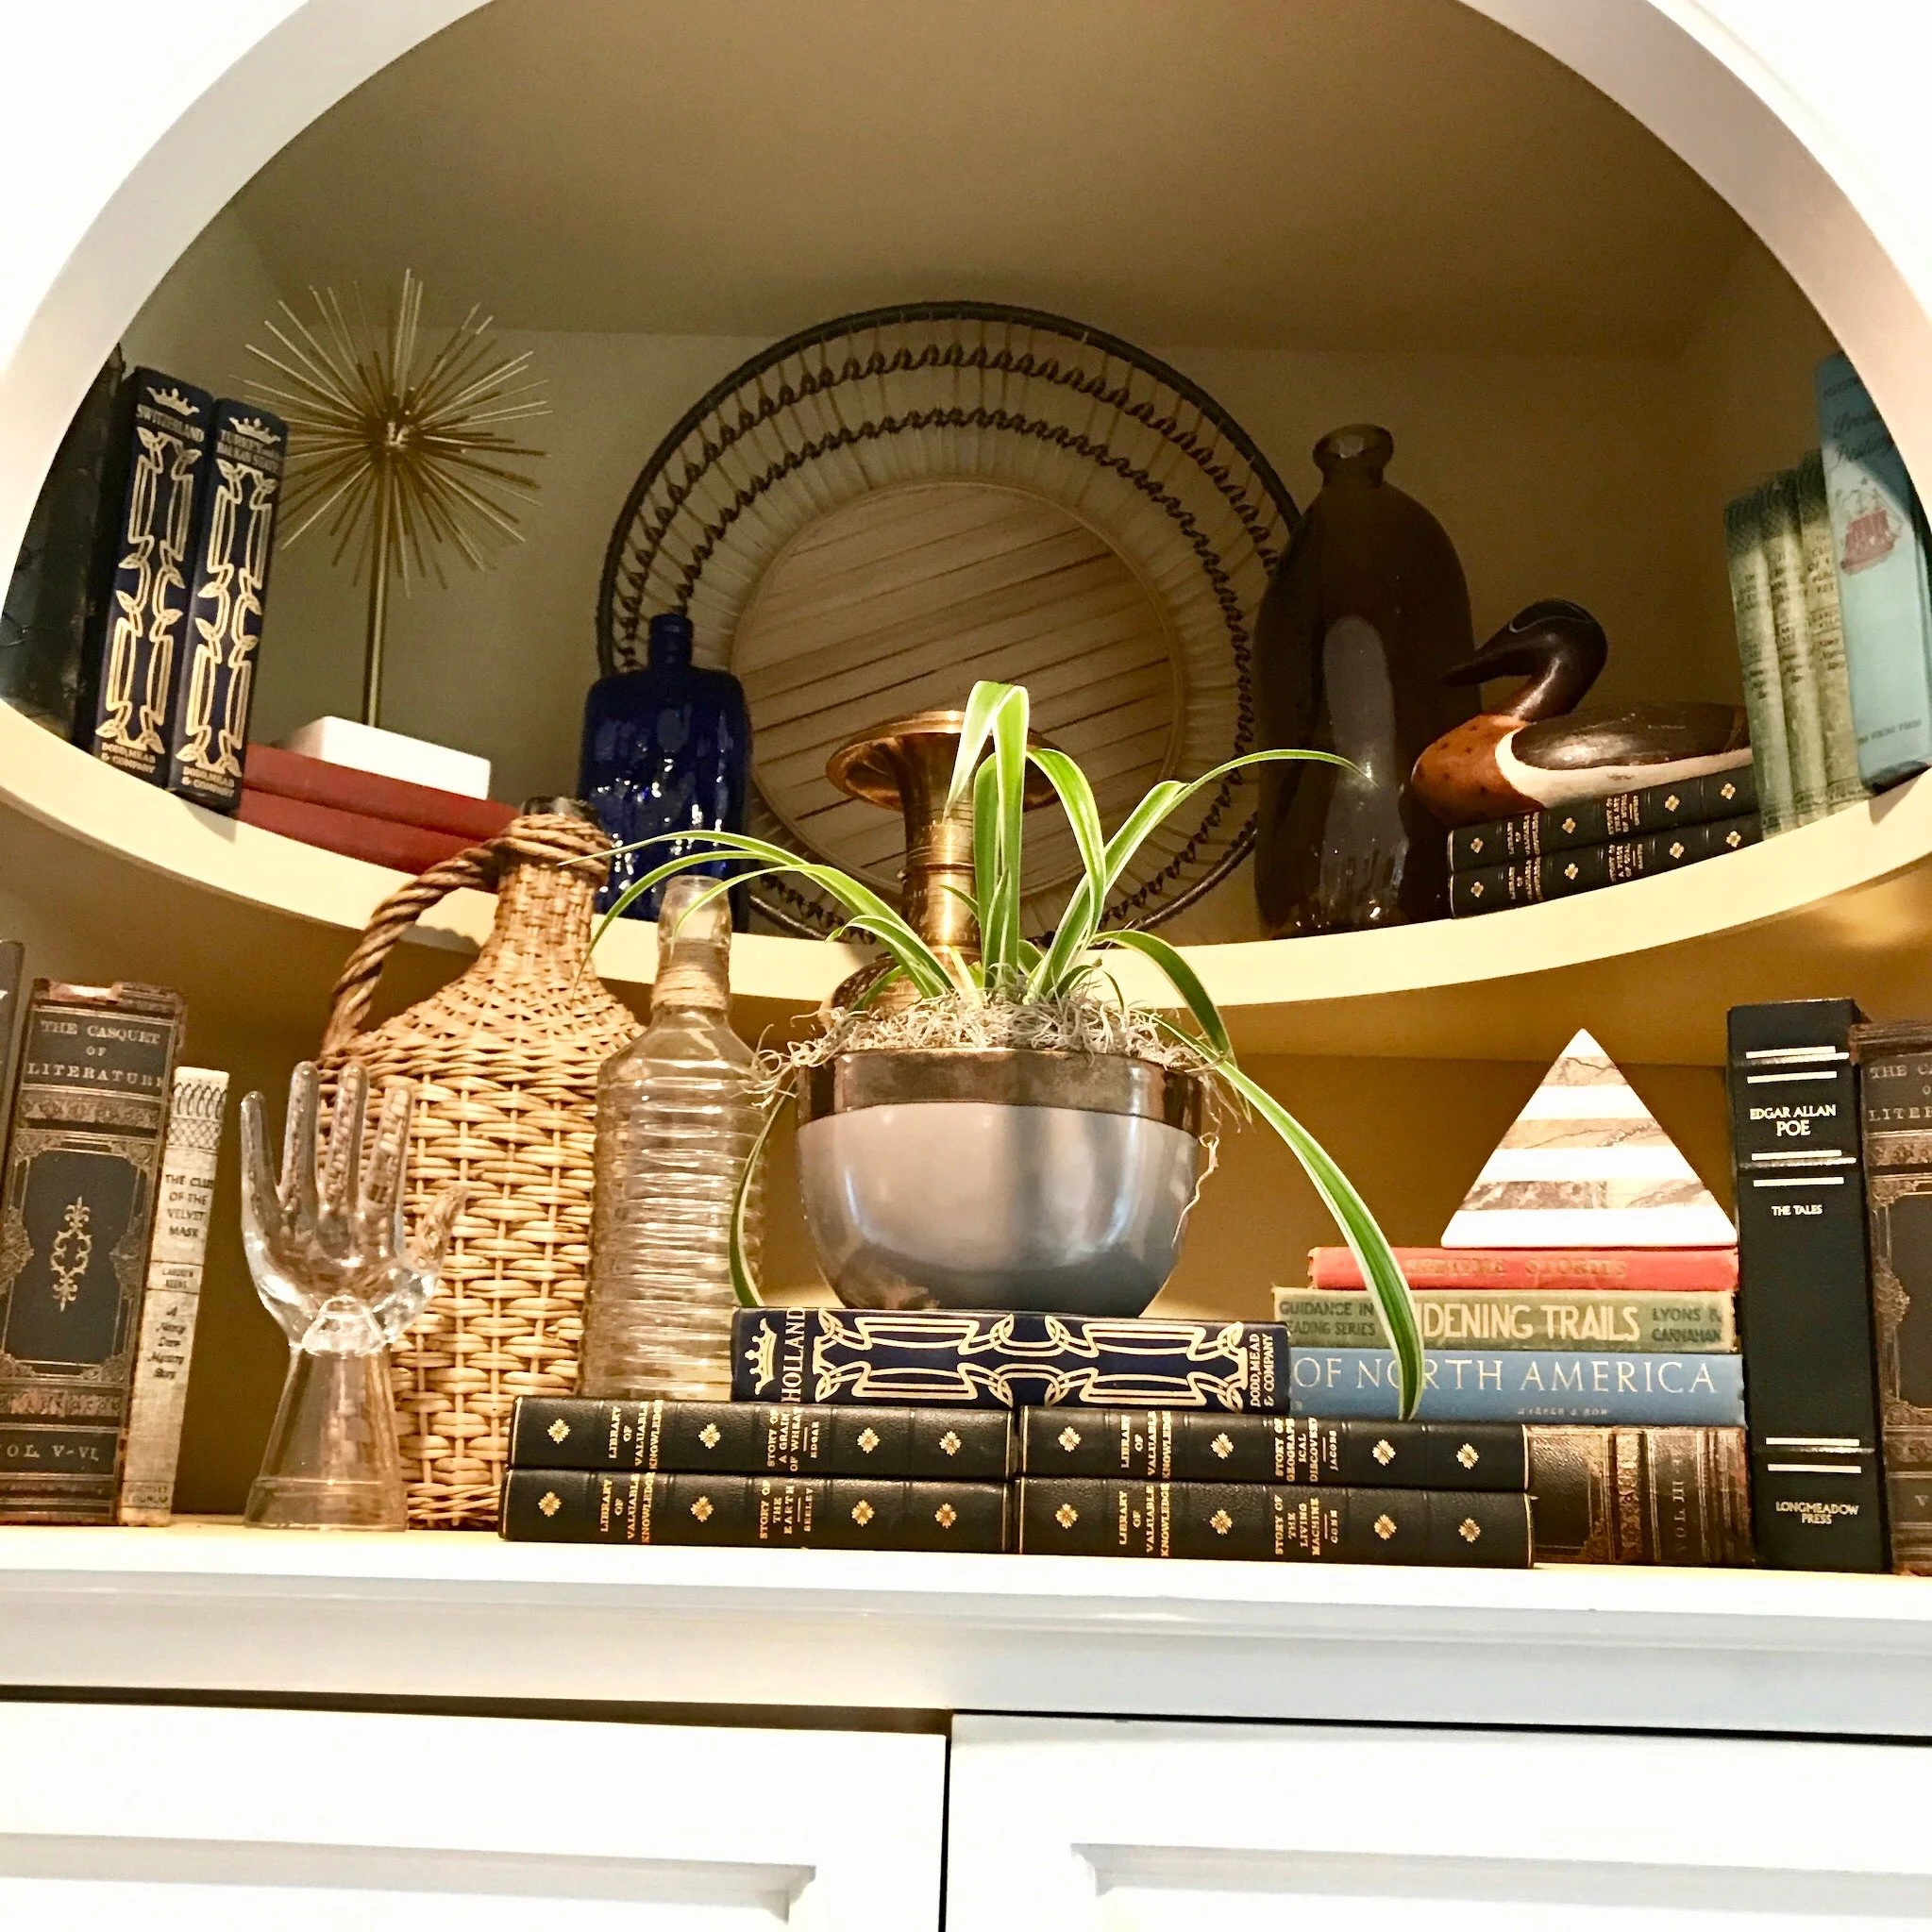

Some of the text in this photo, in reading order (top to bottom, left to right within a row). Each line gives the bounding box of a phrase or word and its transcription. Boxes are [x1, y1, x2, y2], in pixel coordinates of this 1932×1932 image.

[41, 1020, 160, 1045] THE CASQUET
[86, 1046, 107, 1057] OF
[1869, 1065, 1907, 1079] THE
[1750, 1104, 1837, 1120] EDGAR ALLAN
[1775, 1119, 1811, 1137] POE
[165, 1174, 186, 1185] THE
[1772, 1204, 1823, 1217] THE TALES
[1279, 1301, 1374, 1316] GUIDANCE IN
[1415, 1302, 1640, 1341] IDENING TRAILS
[1653, 1308, 1700, 1321] LYONS
[1288, 1321, 1376, 1336] EADING SERIES
[781, 1306, 805, 1403] HOLLAND
[1262, 1333, 1275, 1407] & COMPANY
[1293, 1356, 1342, 1388] OF
[1519, 1360, 1719, 1394] AMERICA
[0, 1445, 40, 1458] OL
[608, 1406, 622, 1459] LIBRARY
[623, 1425, 632, 1443] OF
[634, 1401, 649, 1467] VALUABLE
[766, 1428, 778, 1468] STORY
[779, 1413, 790, 1464] A GRAIN
[789, 1406, 802, 1472] OF WHEAT
[810, 1420, 819, 1459] EDGAR
[1120, 1414, 1131, 1469] LIBRARY
[1134, 1434, 1144, 1453] OF
[1147, 1410, 1157, 1476] VALUABLE
[1274, 1417, 1285, 1477] STORY OF
[1298, 1433, 1307, 1463] ICAL
[1308, 1417, 1319, 1483] DISCOVERY
[600, 1479, 613, 1532] LIBRARY
[613, 1498, 624, 1516] OF
[627, 1473, 641, 1539] VALUABLE
[759, 1479, 771, 1539] STORY OF
[772, 1497, 782, 1524] THE
[783, 1485, 795, 1535] EARTH
[1118, 1490, 1128, 1545] LIBRARY
[1133, 1510, 1142, 1528] OF
[1145, 1485, 1154, 1553] VALUABLE
[1160, 1483, 1170, 1557] KNOWLEDGE
[1274, 1494, 1285, 1555] STORY OF
[1775, 1501, 1859, 1516] LONGMEADOW
[1801, 1513, 1832, 1525] PRESS
[1287, 1512, 1297, 1540] THE
[1299, 1503, 1309, 1548] LIVING
[1310, 1498, 1320, 1556] MACHINE
